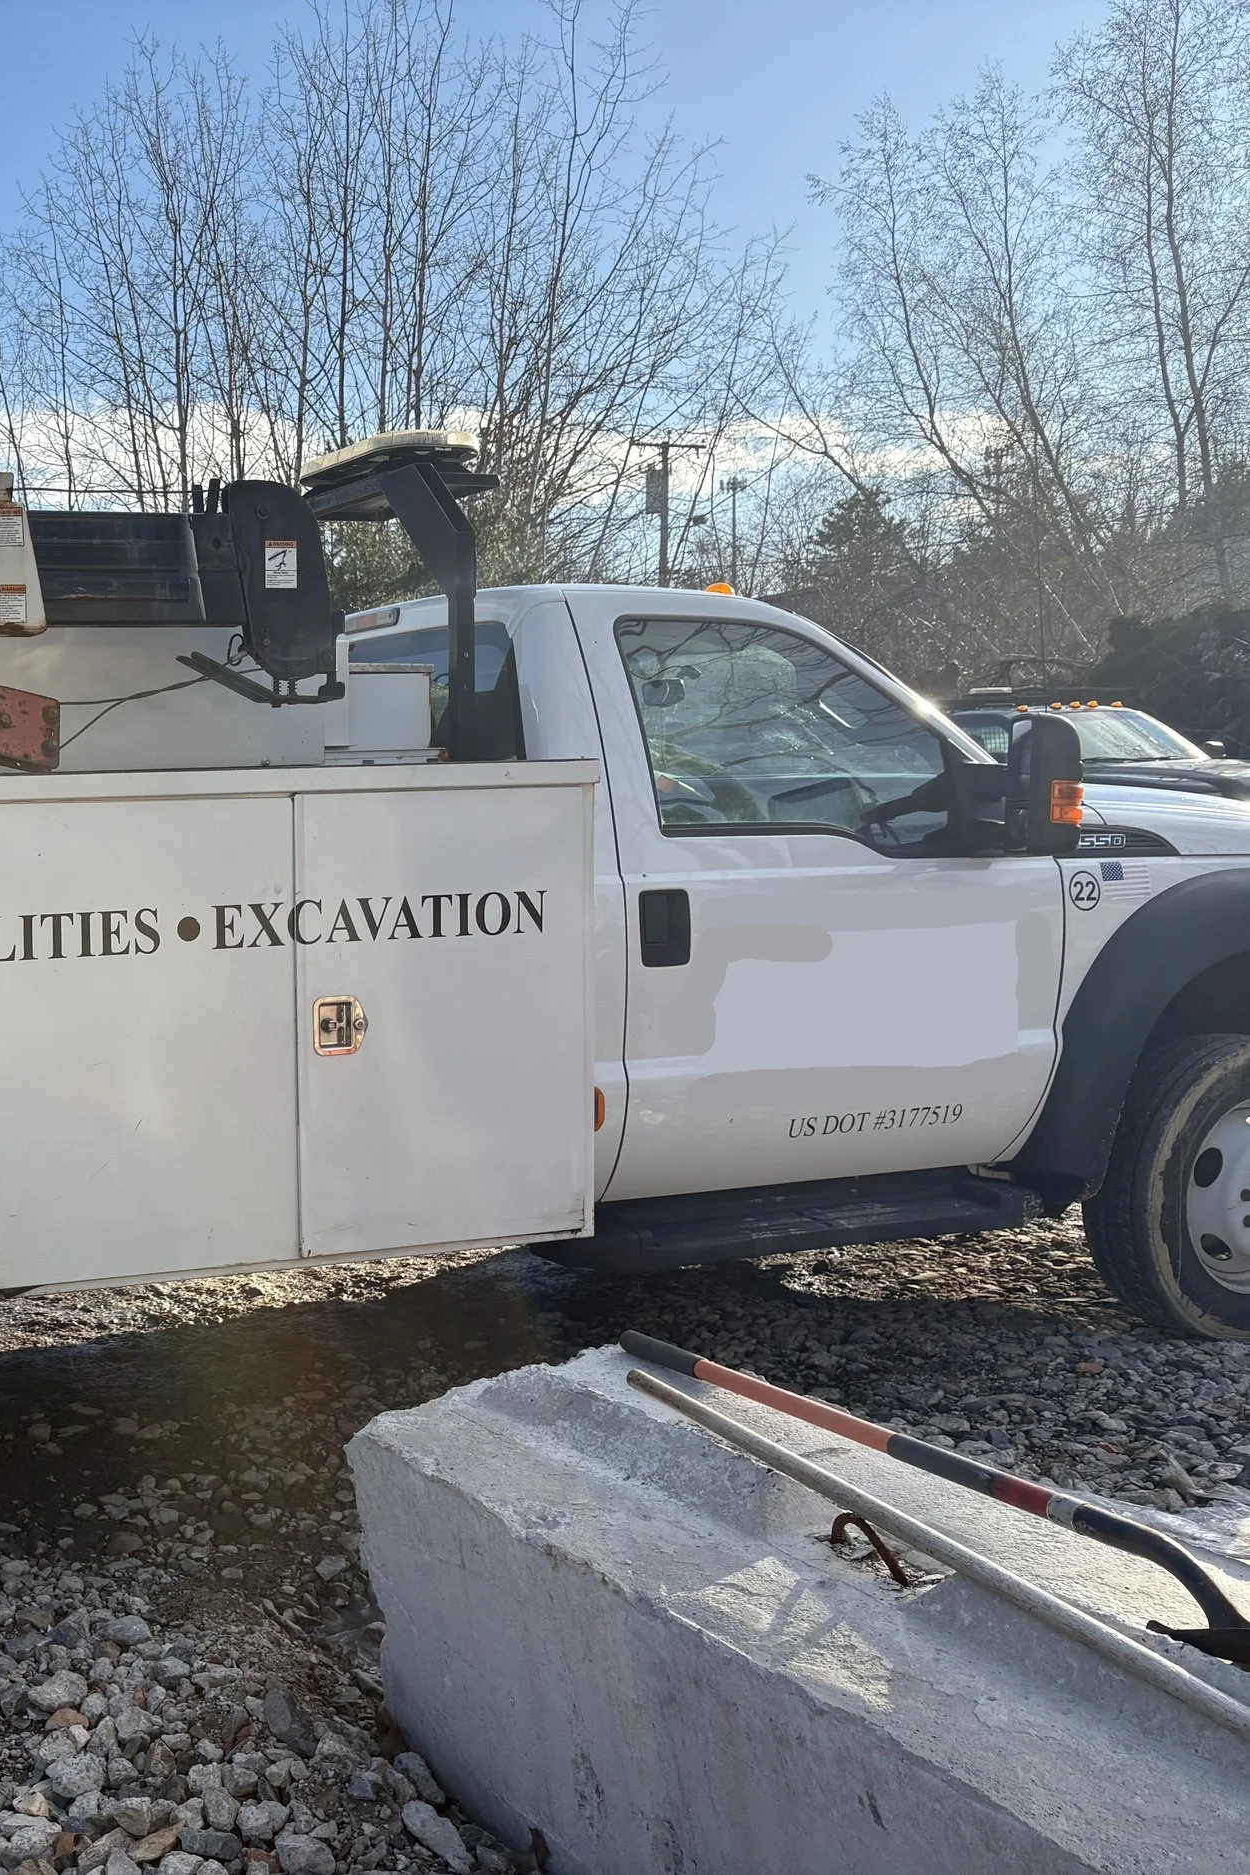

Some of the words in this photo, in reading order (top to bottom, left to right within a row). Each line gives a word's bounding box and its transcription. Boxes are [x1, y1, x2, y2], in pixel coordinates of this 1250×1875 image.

[1073, 880, 1097, 902] 22
[211, 890, 547, 950] EXCAVATION
[788, 1116, 817, 1138] US
[822, 1112, 870, 1136] DOT
[873, 1103, 963, 1131] #3177519
